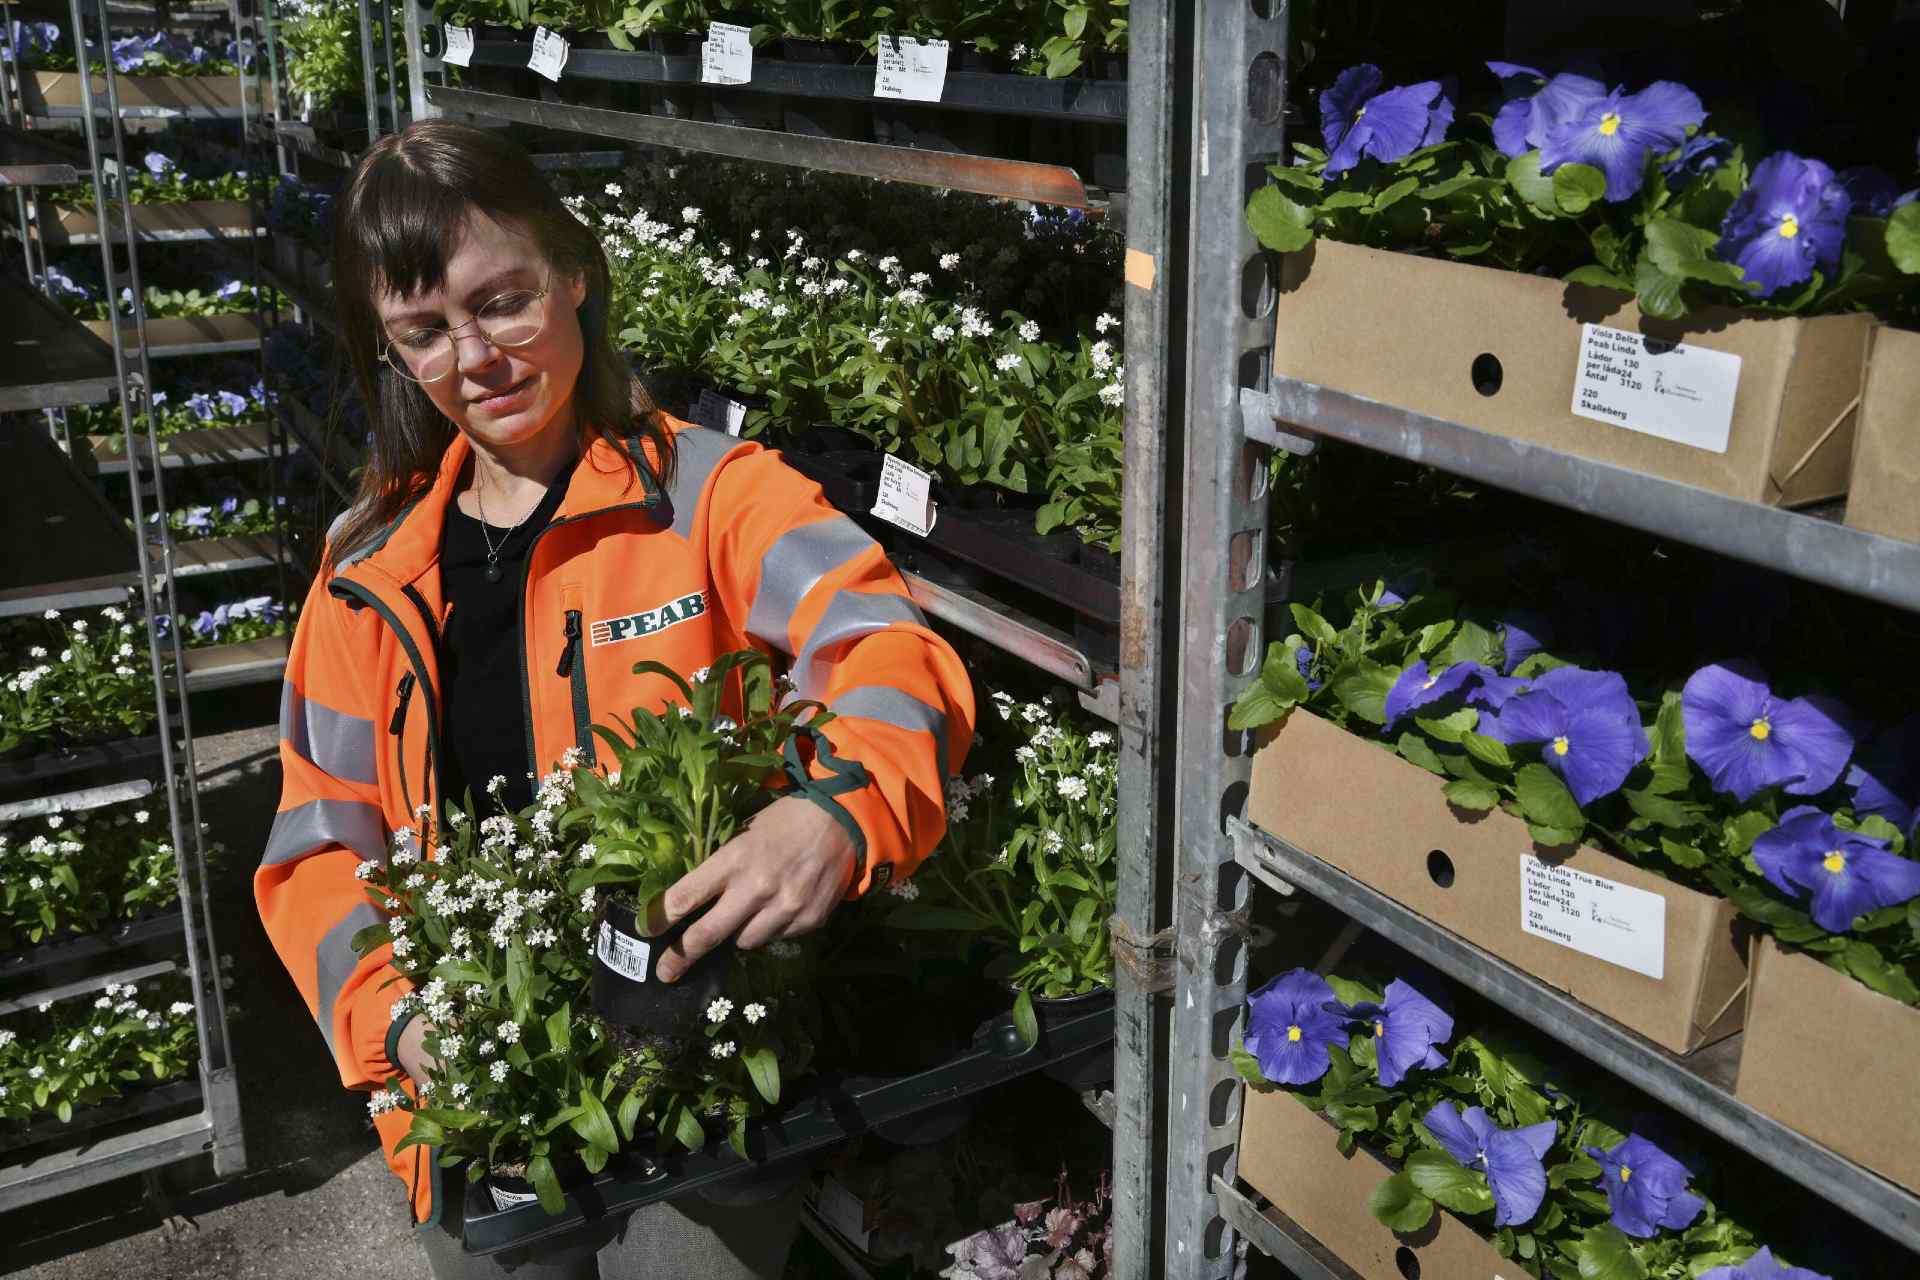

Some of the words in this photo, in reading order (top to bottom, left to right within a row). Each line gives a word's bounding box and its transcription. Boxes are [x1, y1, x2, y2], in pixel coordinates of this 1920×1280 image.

[1591, 327, 1613, 339] Viola
[1615, 333, 1639, 345] Delta
[1588, 337, 1610, 349] Peab
[1612, 343, 1637, 355] Linda
[1586, 361, 1601, 370] per
[1623, 359, 1640, 369] 130
[1585, 370, 1608, 382] Antal
[1620, 378, 1642, 390] 3120
[1582, 388, 1598, 398] 220
[606, 594, 705, 642] PEAB
[1526, 866, 1546, 879] Peab
[1548, 872, 1571, 887] Linda
[1528, 858, 1548, 870] Viola
[1549, 865, 1571, 878] Delta
[1573, 872, 1592, 885] True
[1595, 879, 1614, 891] Blue
[1528, 887, 1541, 896] per
[1560, 889, 1575, 899] 130
[1528, 895, 1550, 907] Antal
[1560, 905, 1580, 918] 3120
[1529, 910, 1543, 920] 220
